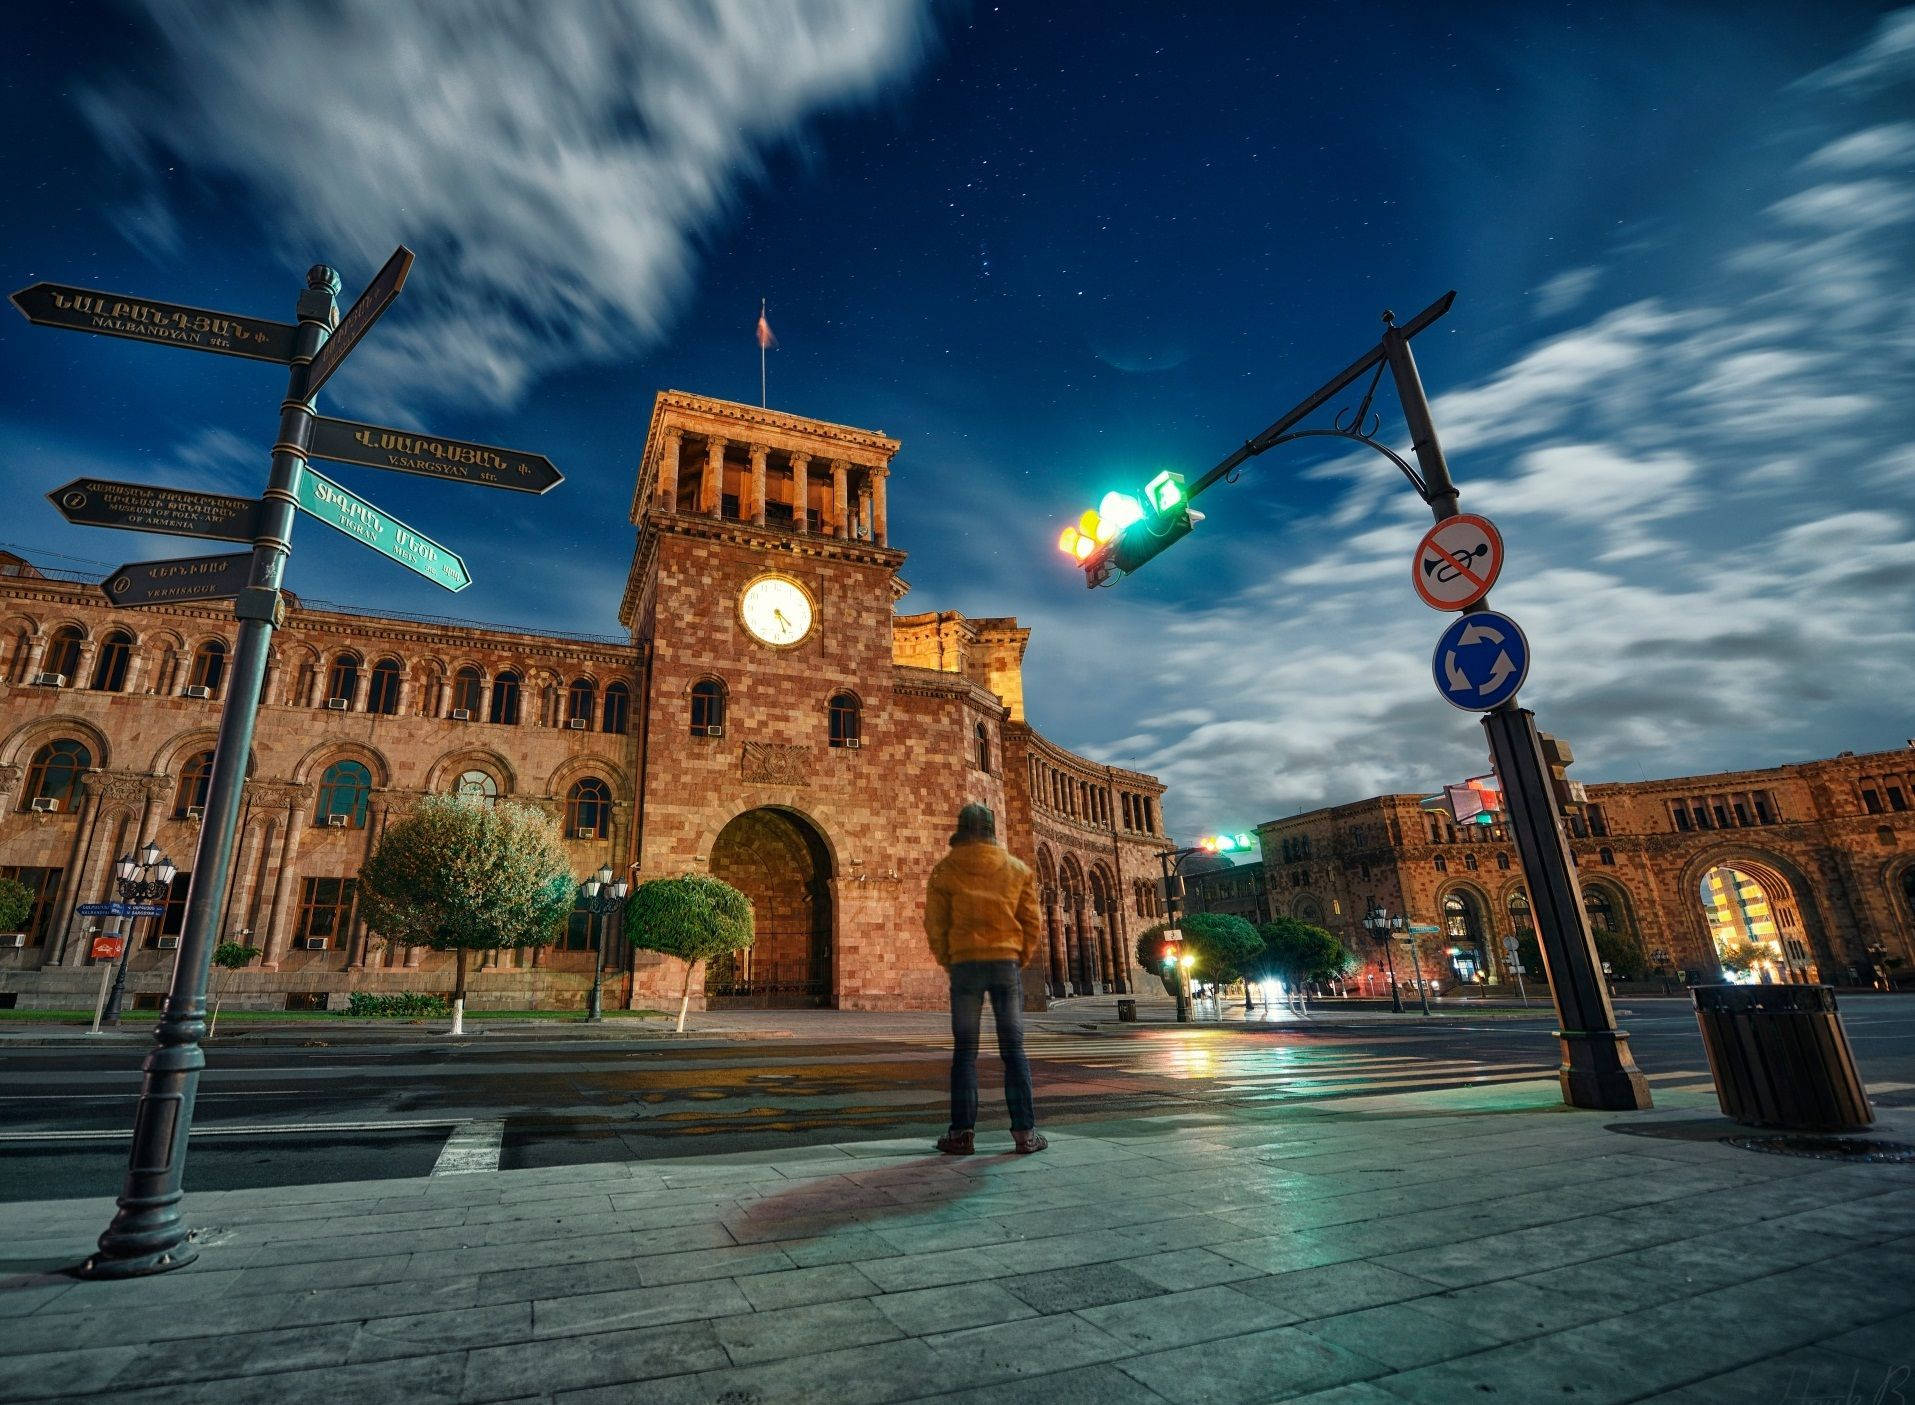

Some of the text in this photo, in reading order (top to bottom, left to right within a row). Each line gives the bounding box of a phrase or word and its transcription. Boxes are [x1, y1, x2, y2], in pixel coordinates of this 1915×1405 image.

[92, 316, 200, 343] NALBANDYAN
[109, 503, 152, 515] MUSEUM
[156, 509, 168, 517] OF
[128, 515, 194, 530] OF ARMENIA
[338, 514, 377, 543] TIGRAN
